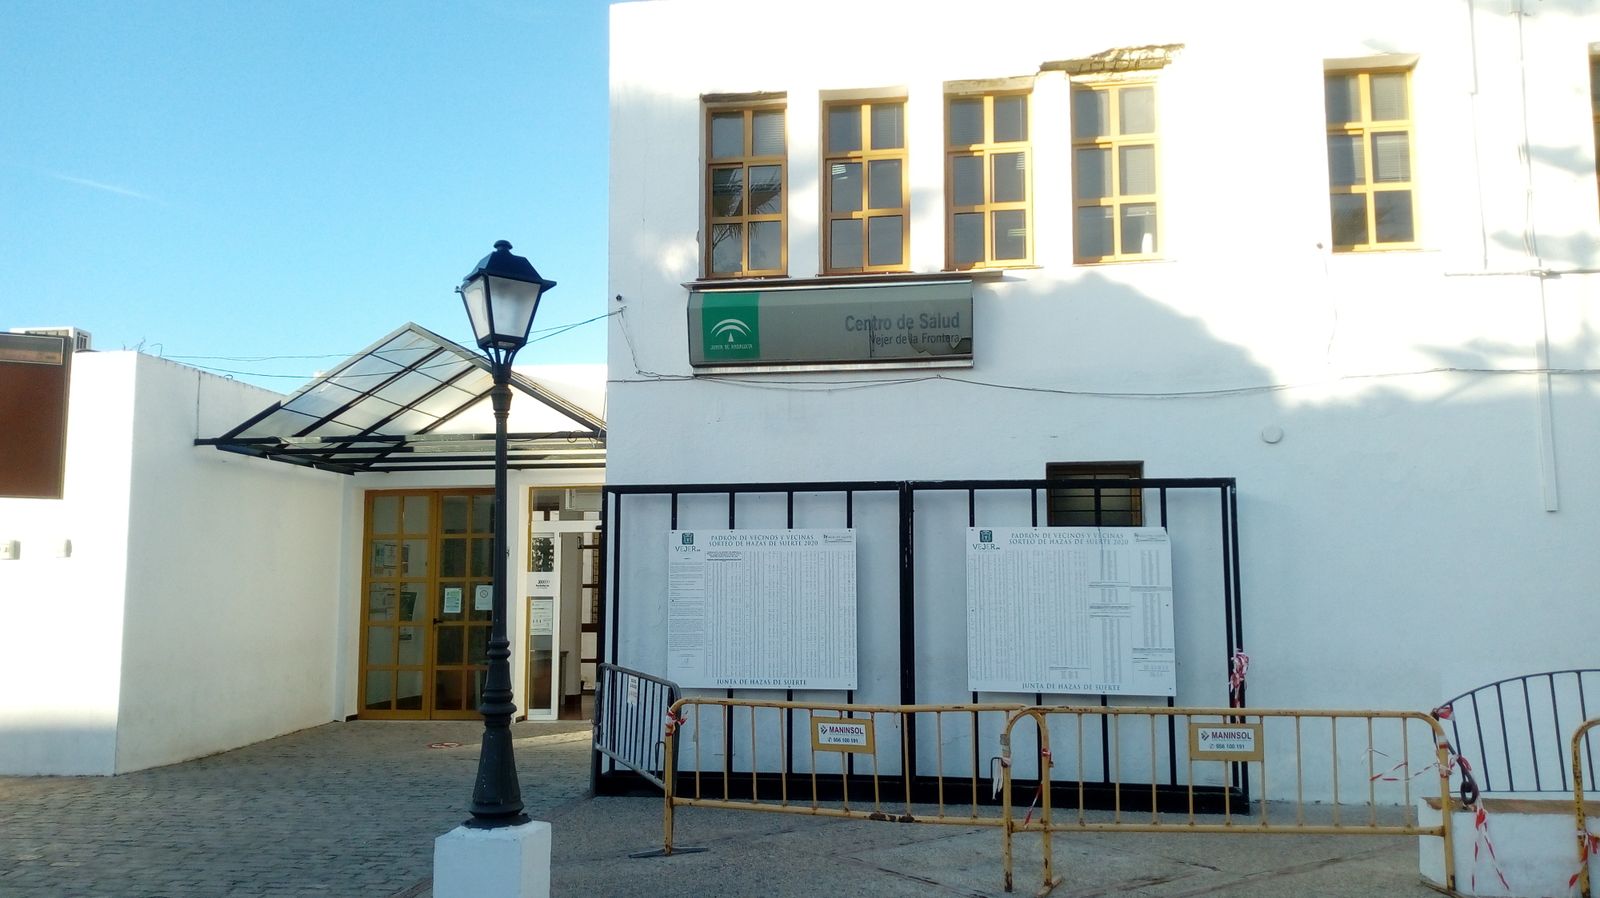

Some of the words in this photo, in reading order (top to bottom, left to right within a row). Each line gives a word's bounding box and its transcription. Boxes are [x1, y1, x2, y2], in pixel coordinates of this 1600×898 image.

[845, 315, 892, 331] Centro
[896, 313, 915, 330] de
[919, 311, 960, 329] Salud
[871, 335, 893, 346] Vejer
[895, 333, 907, 345] de
[909, 333, 918, 343] la
[921, 333, 960, 344] Frontera
[829, 726, 864, 735] MANINSOL
[1211, 731, 1252, 740] MANINSOL
